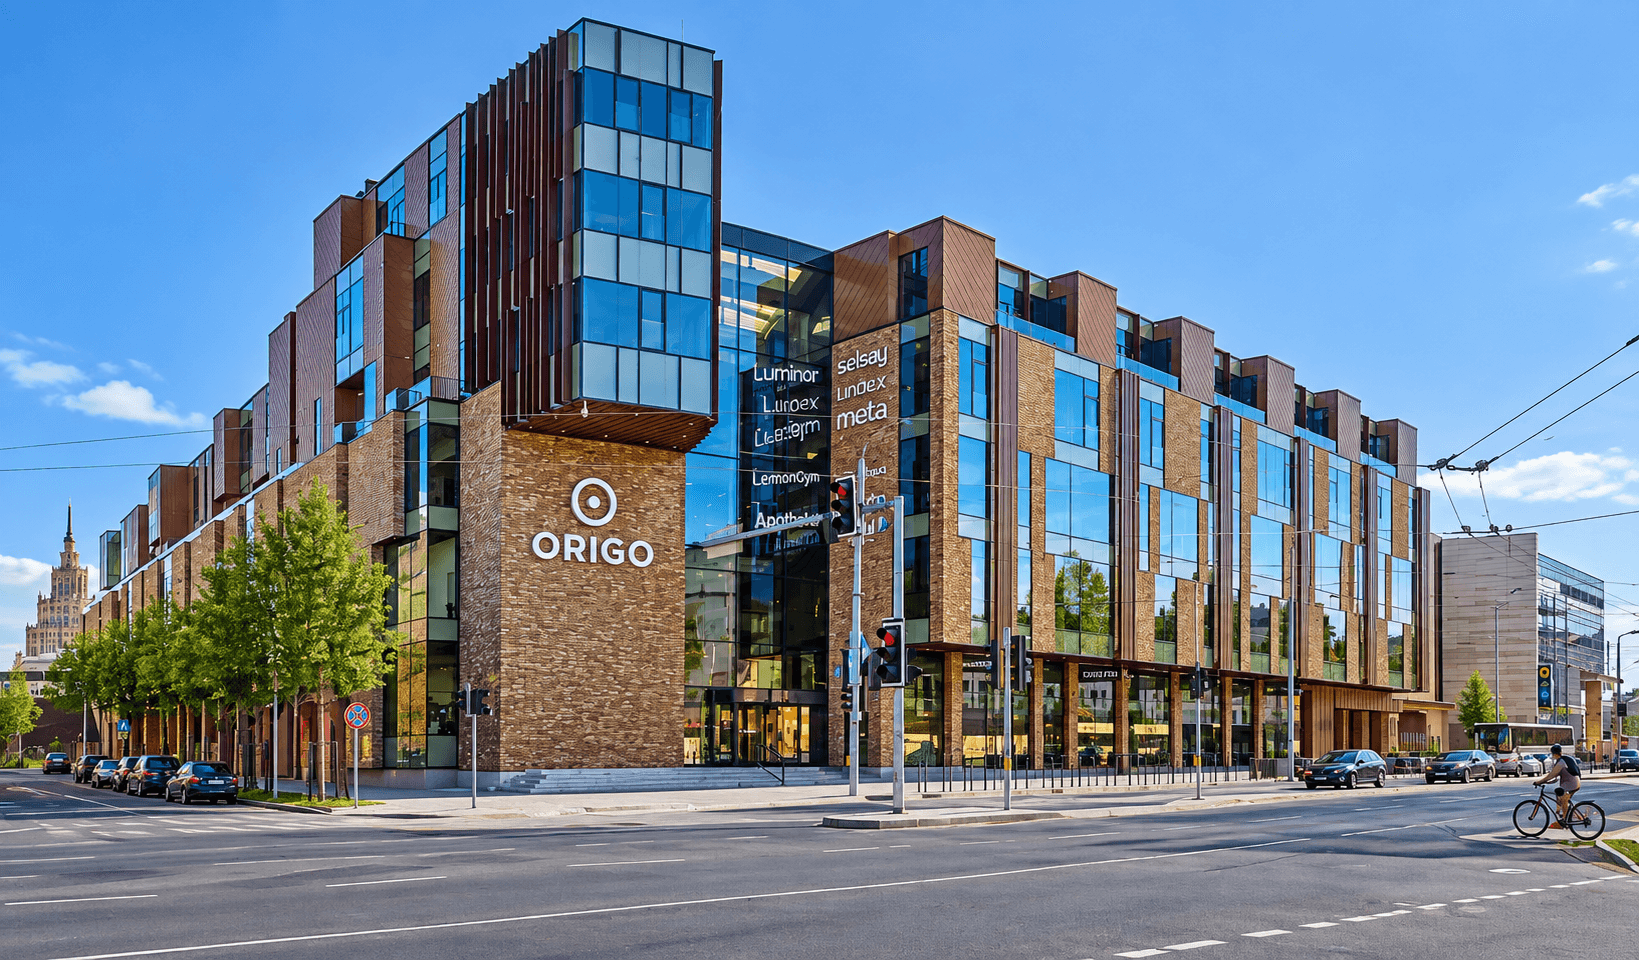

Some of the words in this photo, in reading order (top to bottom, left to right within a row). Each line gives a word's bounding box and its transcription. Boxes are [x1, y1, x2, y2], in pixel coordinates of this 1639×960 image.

[754, 363, 819, 383] Luminor
[837, 346, 888, 375] selsay
[837, 400, 888, 431] meta
[752, 470, 820, 487] LemonGym
[532, 531, 654, 568] ORIGO
